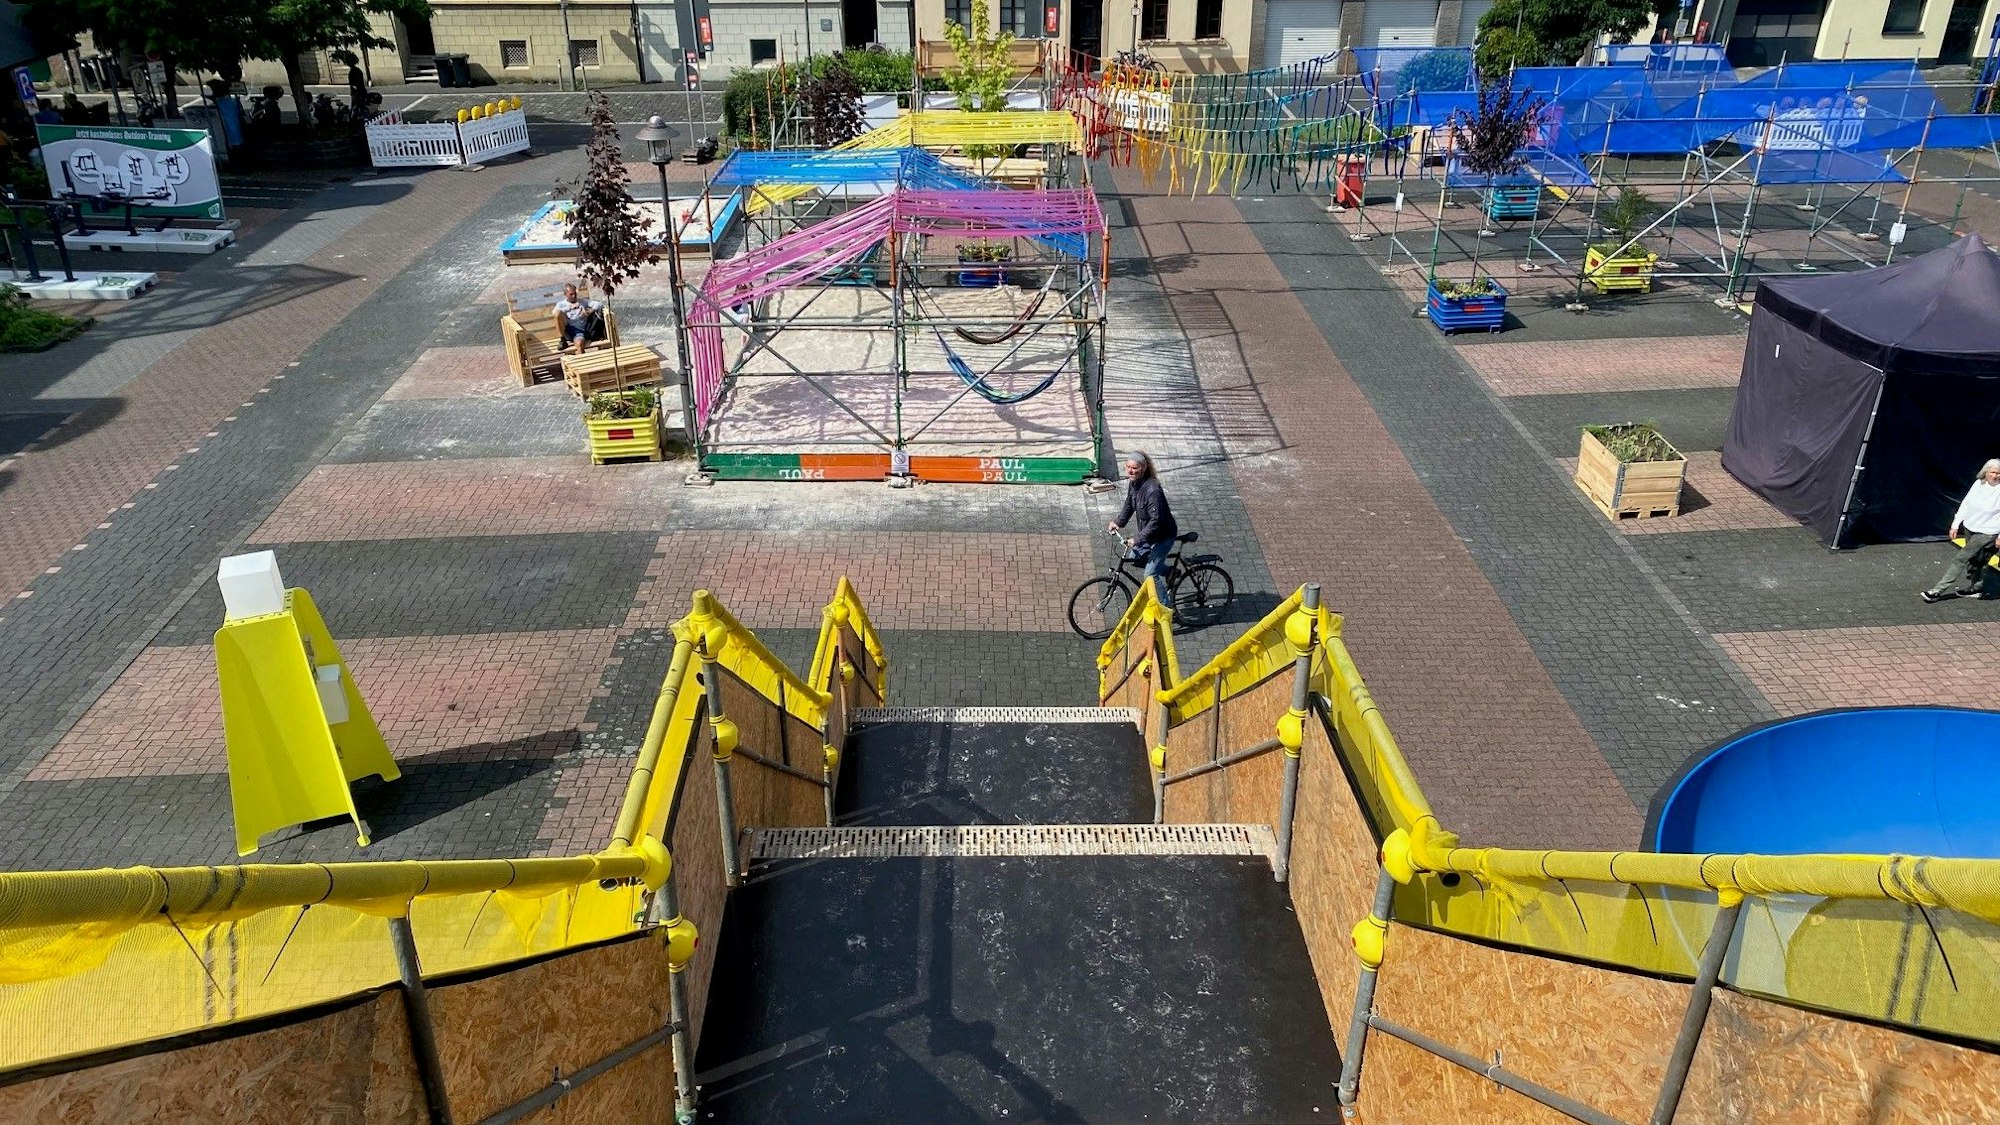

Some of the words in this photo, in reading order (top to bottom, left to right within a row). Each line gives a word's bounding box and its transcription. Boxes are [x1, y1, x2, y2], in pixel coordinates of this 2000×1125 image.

[979, 459, 1024, 469] PAUL
[779, 469, 824, 479] PAUL
[982, 471, 1027, 482] PAUL
